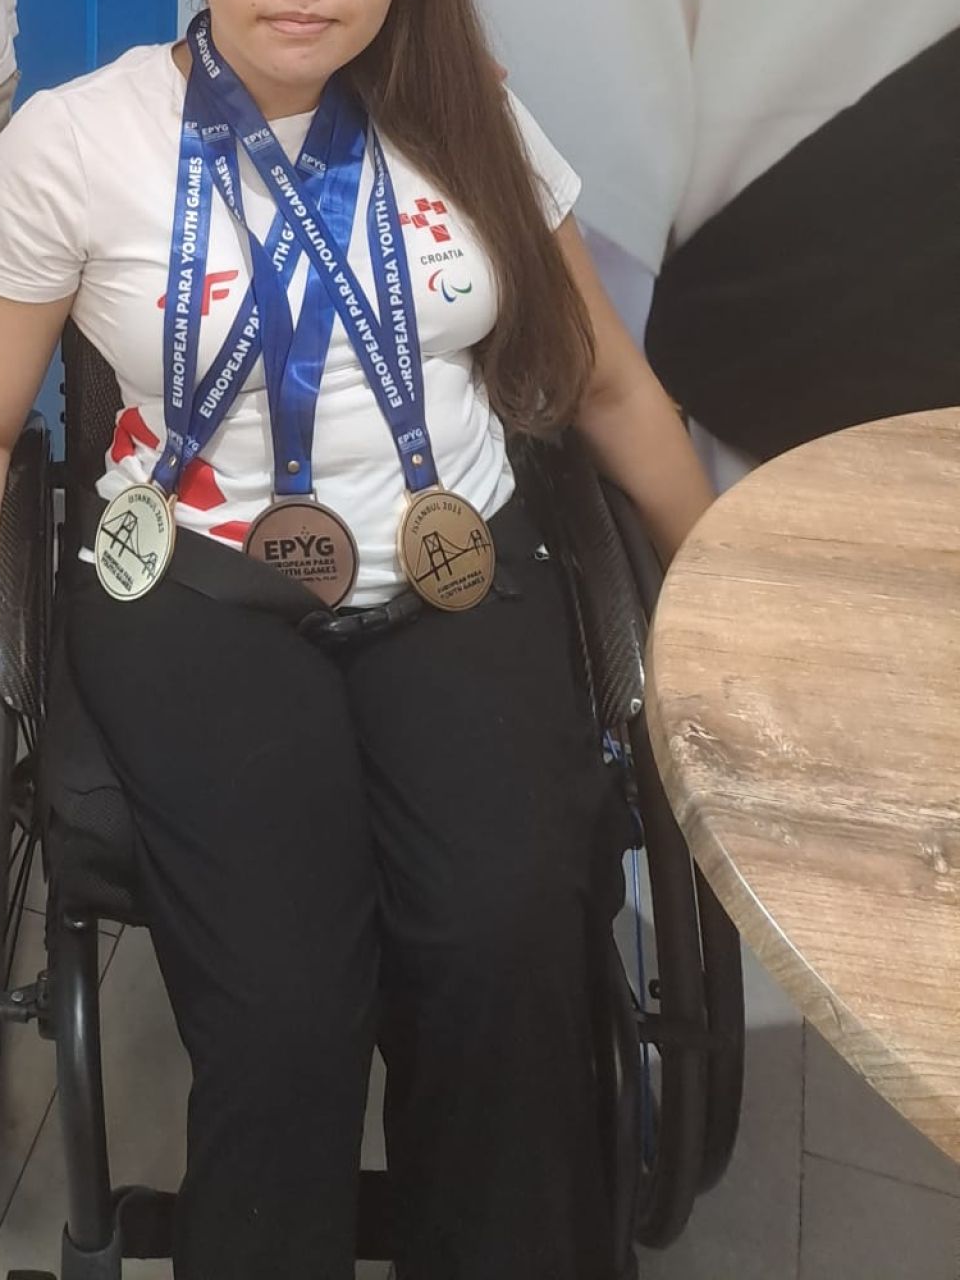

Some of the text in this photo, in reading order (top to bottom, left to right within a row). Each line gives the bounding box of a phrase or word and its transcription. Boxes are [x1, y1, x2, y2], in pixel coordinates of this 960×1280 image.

[202, 124, 229, 136] EPYG
[243, 128, 270, 145] EPYG
[301, 153, 326, 171] EPYG
[270, 165, 307, 217] GAMES
[301, 218, 338, 272] YOUTH
[376, 201, 394, 257] YOUTH
[420, 249, 464, 265] CROATIA
[172, 156, 203, 408] EUROPEAN PARA YOUTH GAMES
[334, 272, 363, 318] PARA
[386, 259, 404, 305] PARA
[199, 338, 251, 419] EUROPEAN
[356, 318, 403, 409] EUROPEAN
[398, 428, 423, 445] EPYG
[264, 535, 334, 560] EPYG
[303, 566, 337, 576] GAMES
